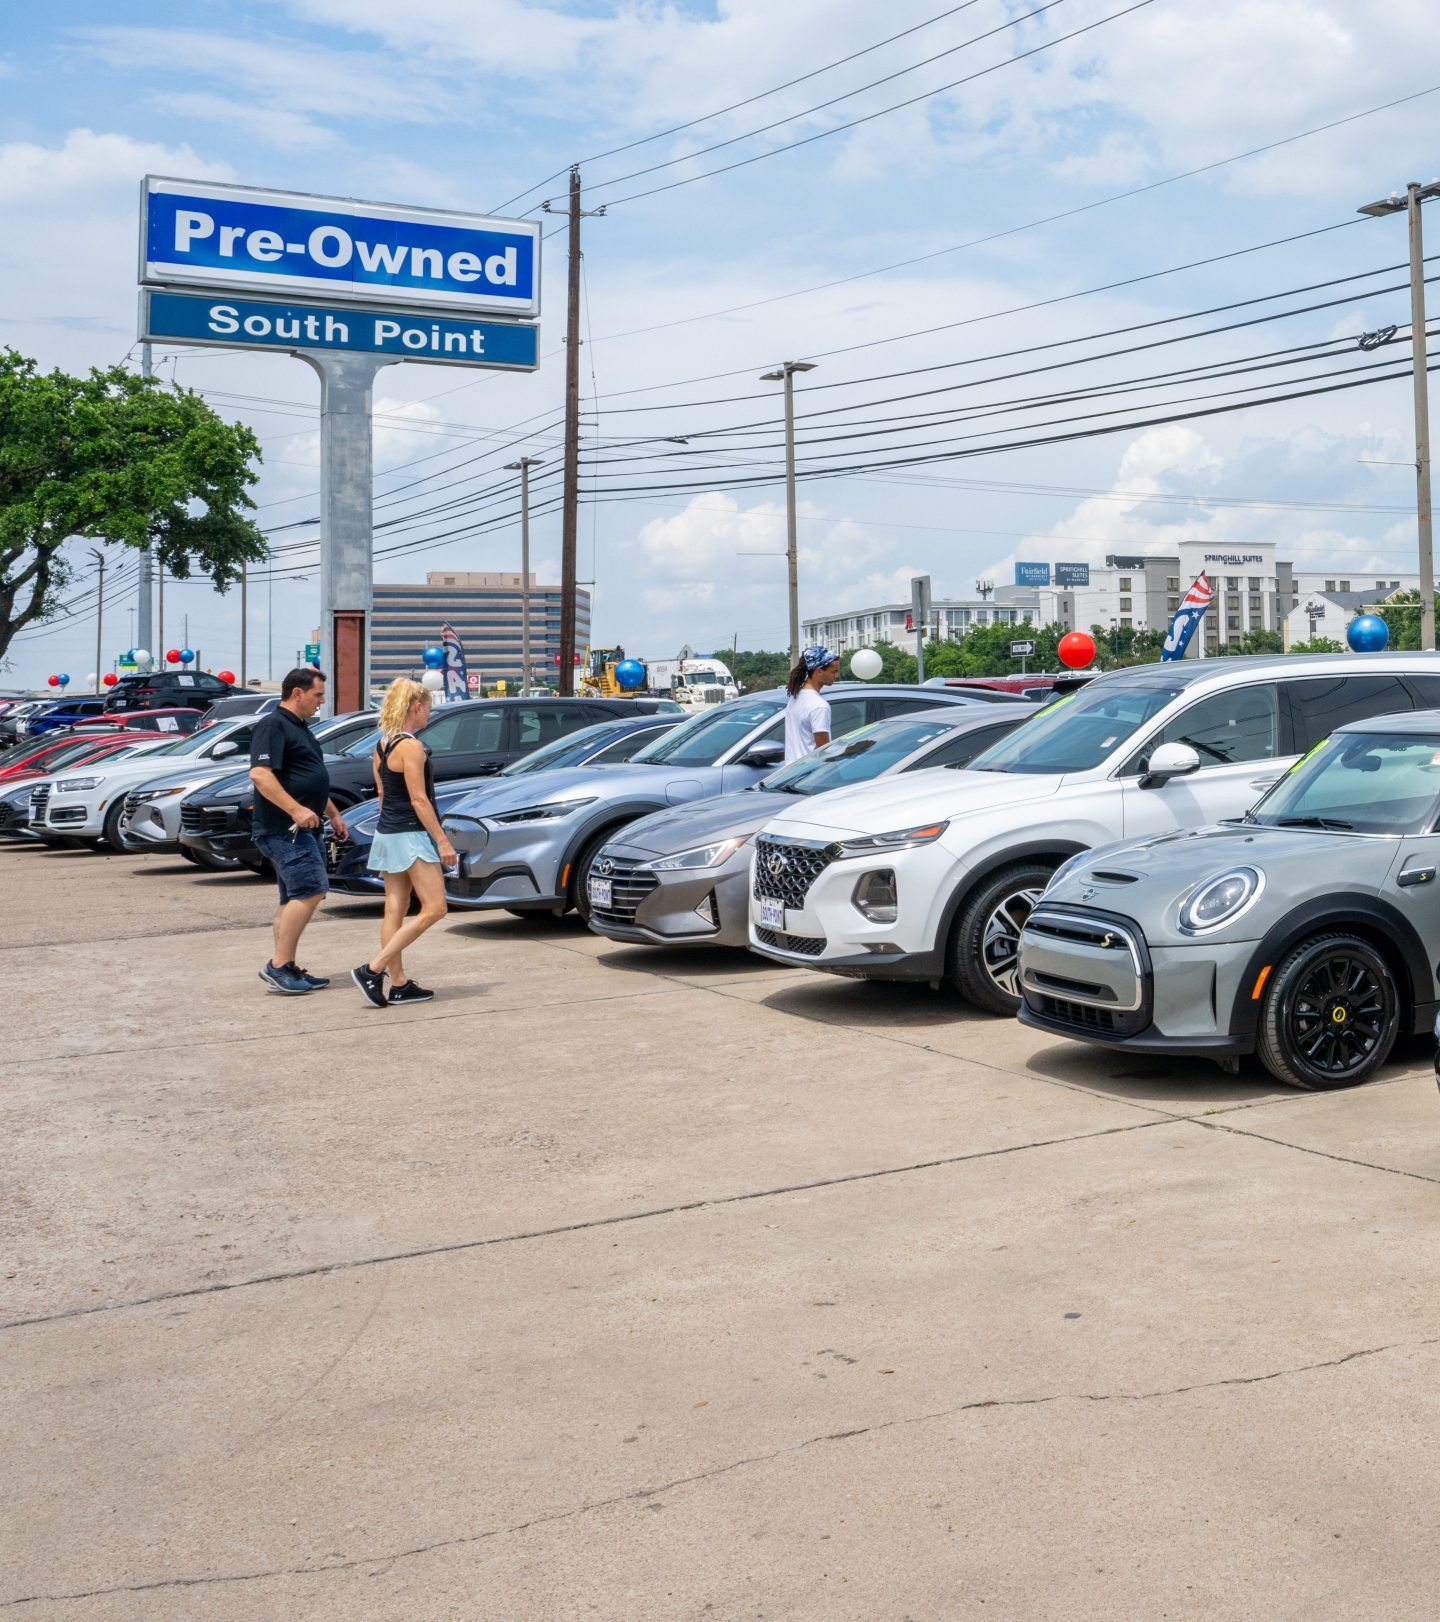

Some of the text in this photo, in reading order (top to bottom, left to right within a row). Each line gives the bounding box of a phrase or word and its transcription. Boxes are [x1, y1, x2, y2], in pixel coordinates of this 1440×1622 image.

[174, 209, 517, 286] Pre-Owned
[208, 305, 486, 354] South Point
[1021, 567, 1048, 575] Fairfield
[1204, 554, 1241, 562] SPRINGHILL
